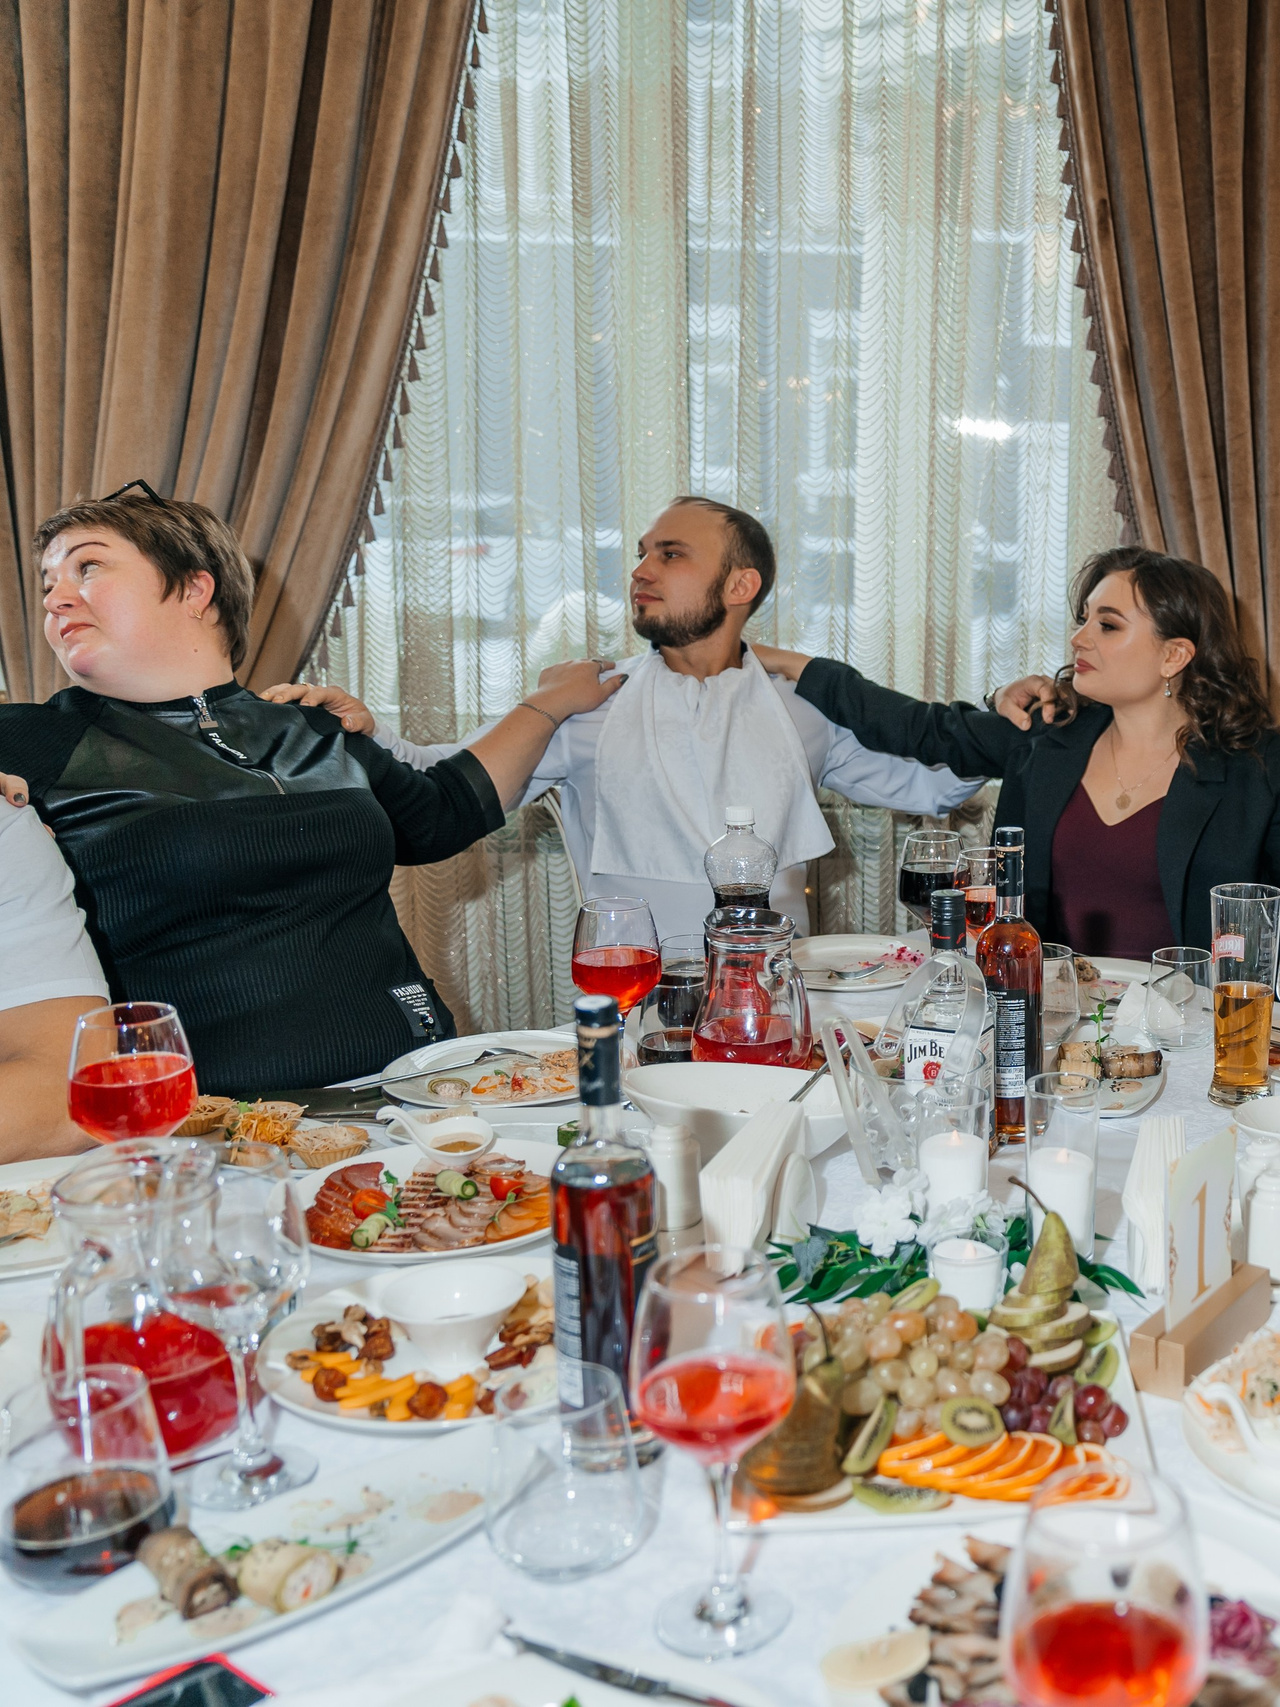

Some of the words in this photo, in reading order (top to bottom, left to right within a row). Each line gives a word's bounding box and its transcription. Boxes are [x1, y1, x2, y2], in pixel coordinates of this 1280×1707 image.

[392, 984, 425, 998] FASHION
[907, 1042, 927, 1063] JIM
[929, 1039, 946, 1059] BE
[1191, 1179, 1212, 1303] 1
